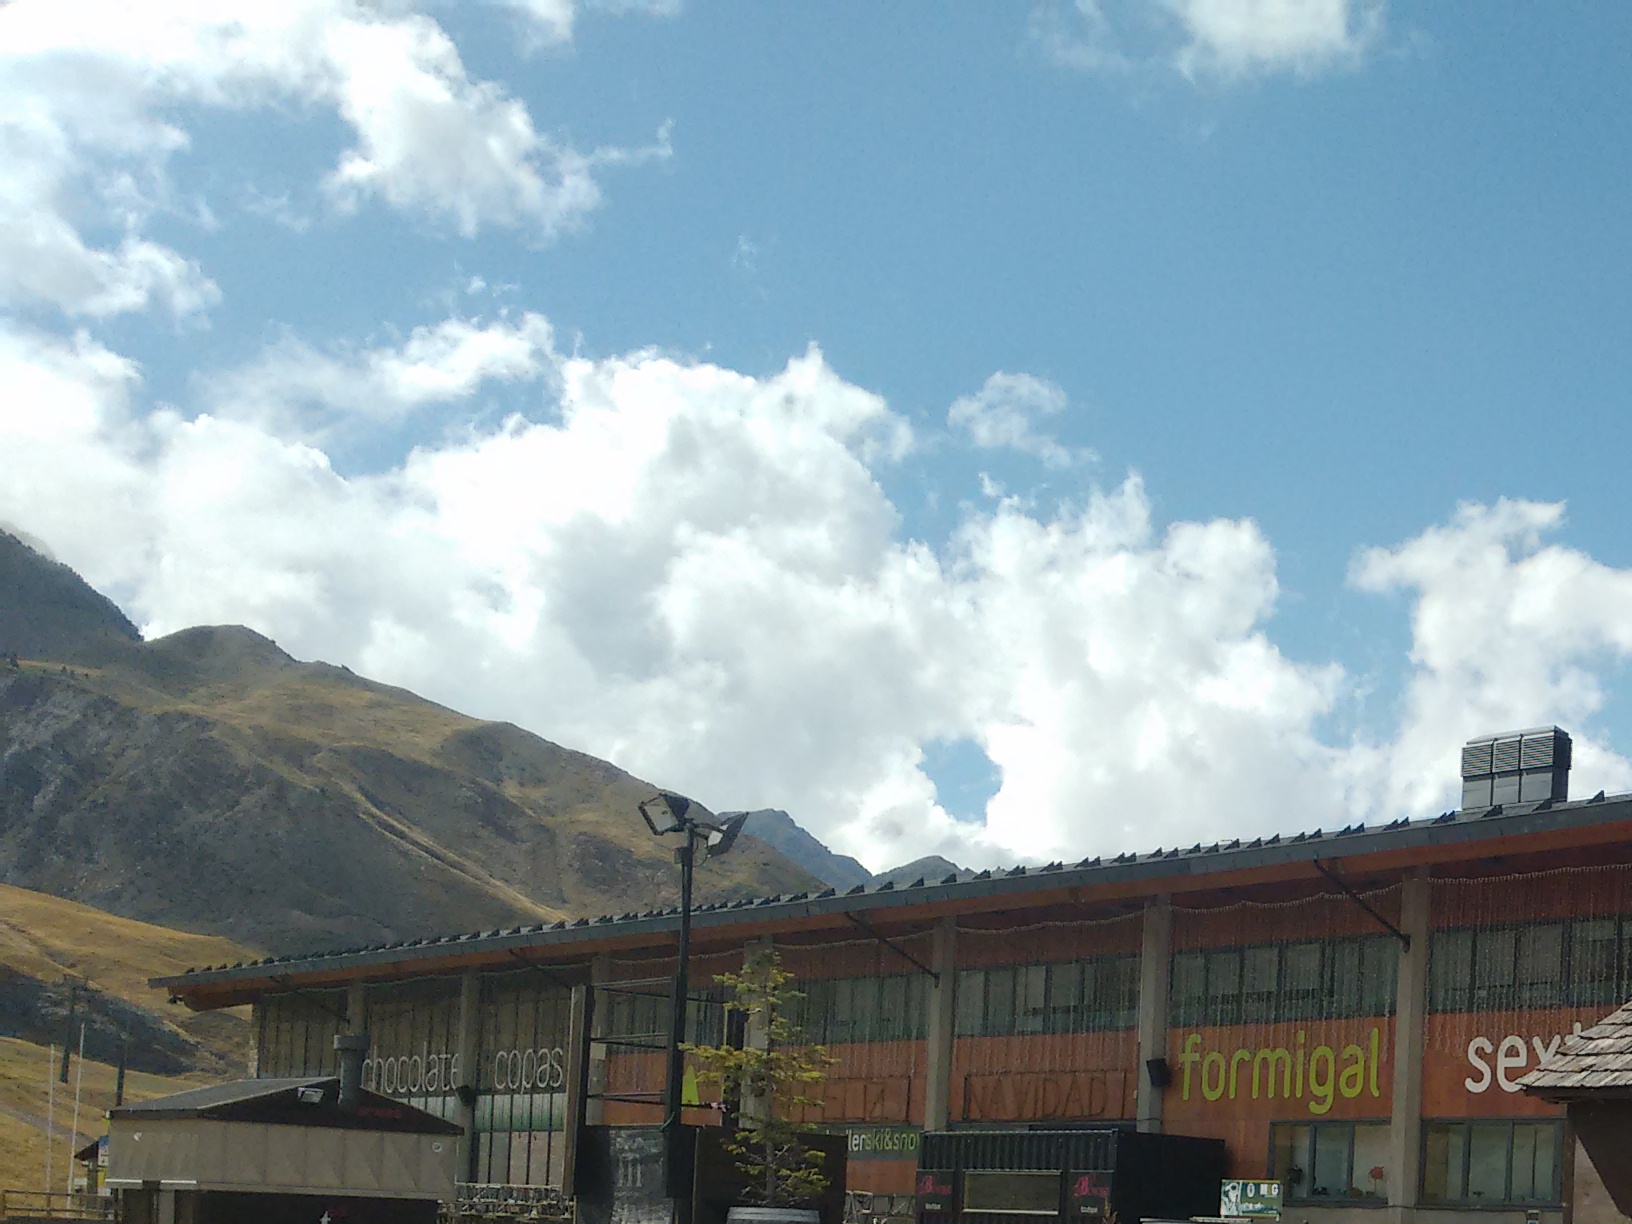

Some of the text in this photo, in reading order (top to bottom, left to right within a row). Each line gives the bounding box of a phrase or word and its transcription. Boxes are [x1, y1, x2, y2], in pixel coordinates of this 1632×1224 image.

[494, 1047, 563, 1095] copas
[1179, 1027, 1379, 1115] formigal
[968, 1076, 1107, 1119] NAVIDAD
